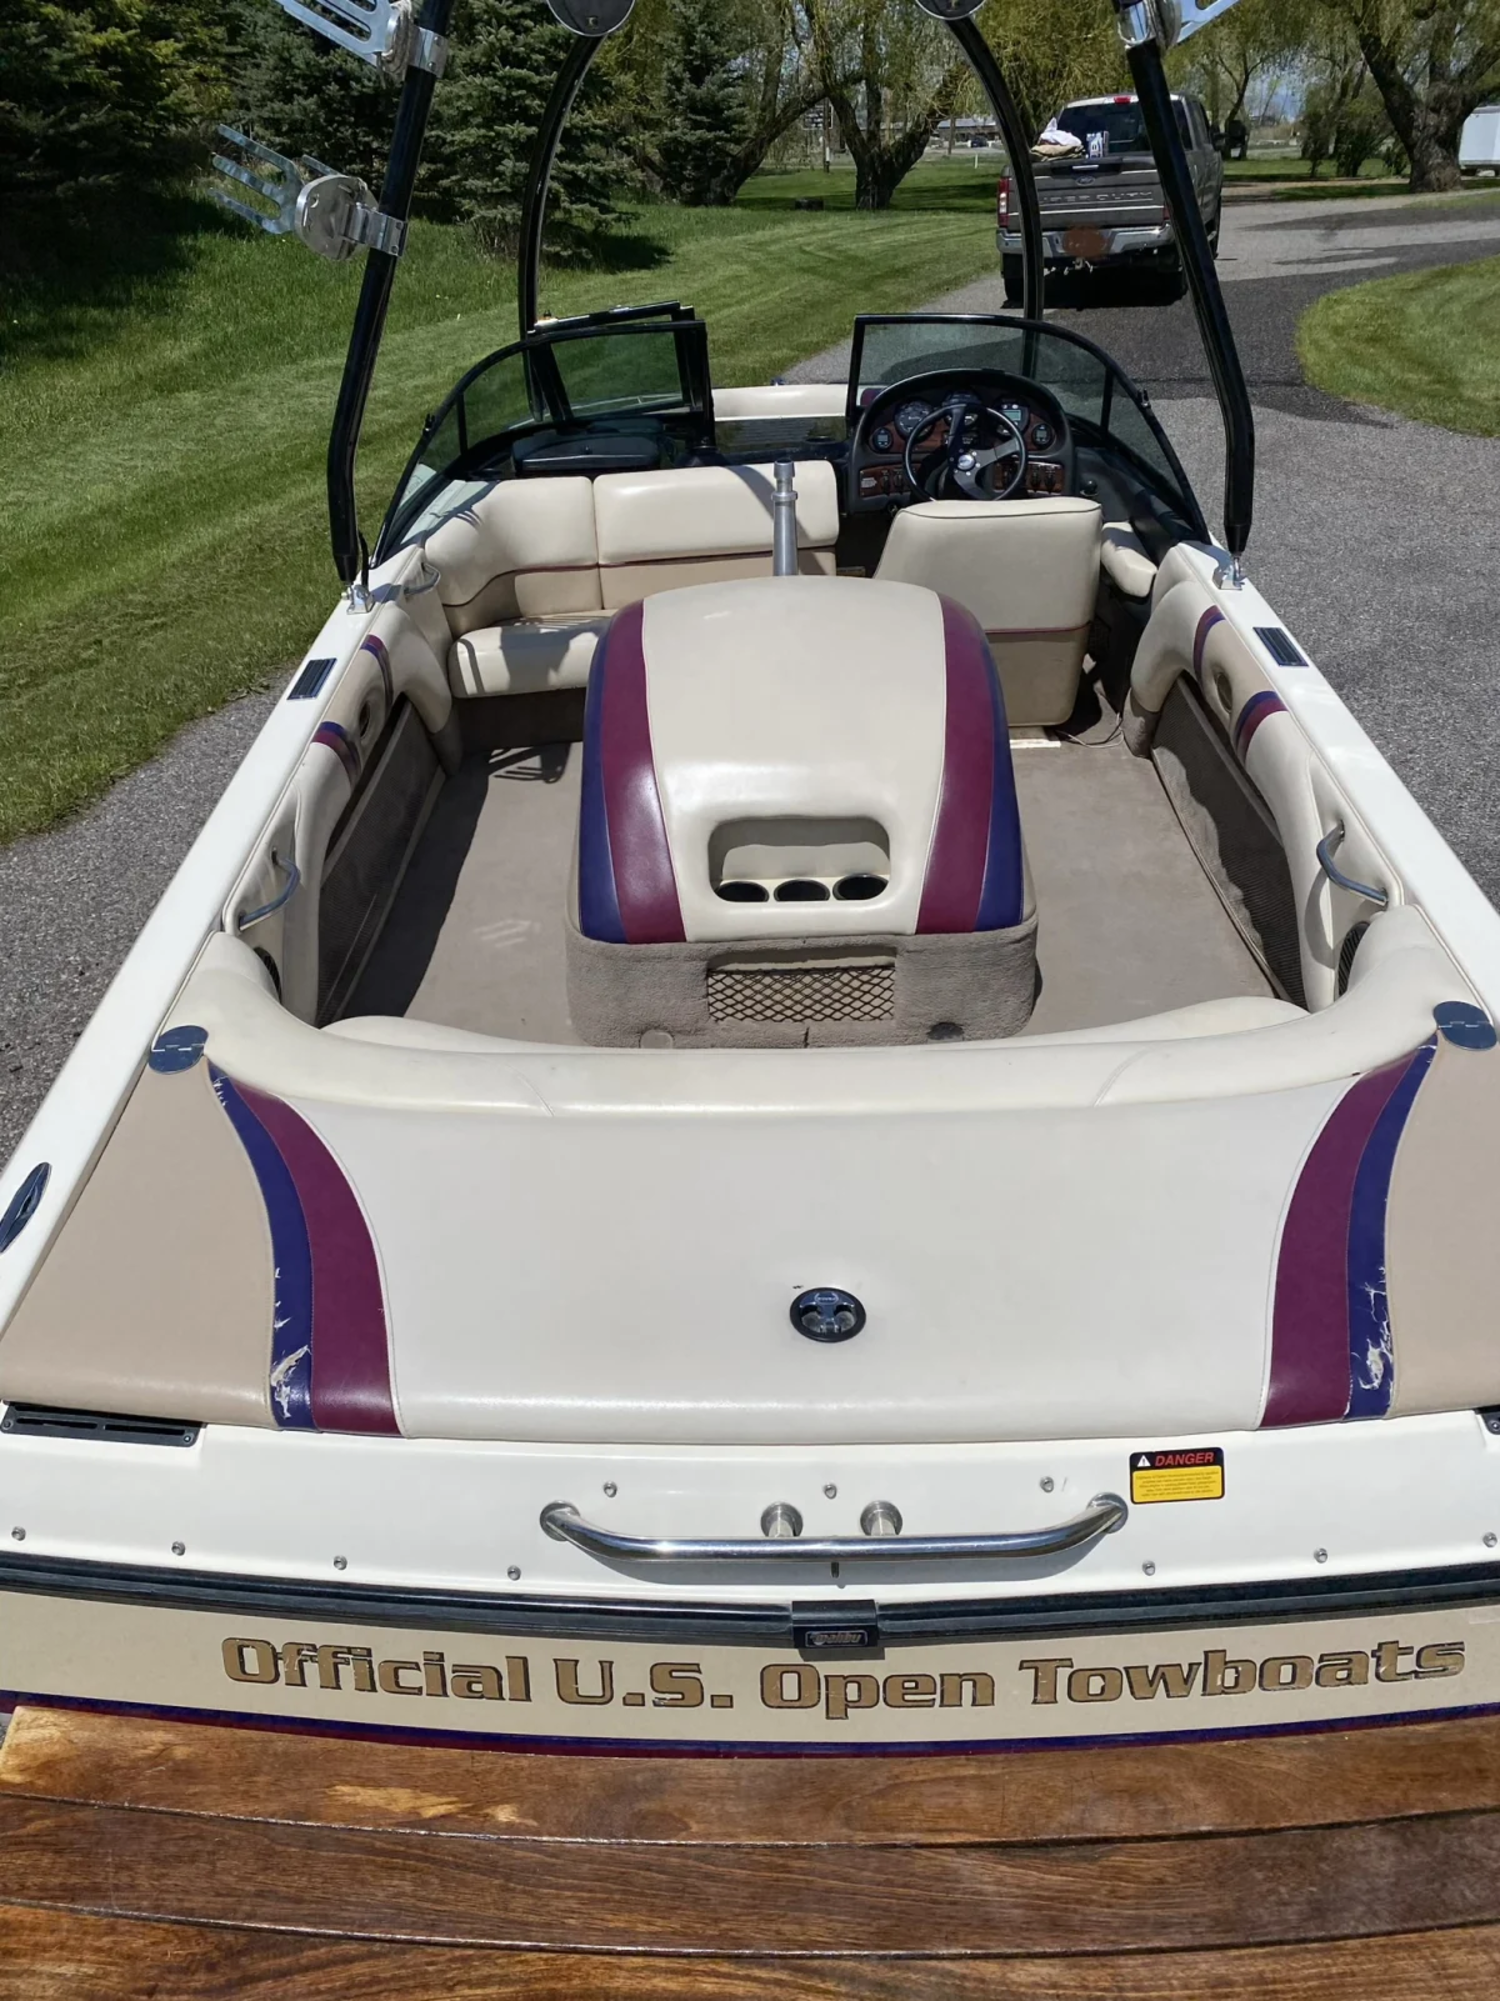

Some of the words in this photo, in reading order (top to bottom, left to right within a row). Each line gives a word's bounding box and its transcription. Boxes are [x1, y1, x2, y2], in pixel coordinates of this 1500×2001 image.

[1155, 1452, 1215, 1467] DANGER
[221, 1637, 531, 1702] Official
[554, 1658, 734, 1708] U.S.
[758, 1662, 995, 1720] Open
[1018, 1640, 1466, 1705] Towboats
